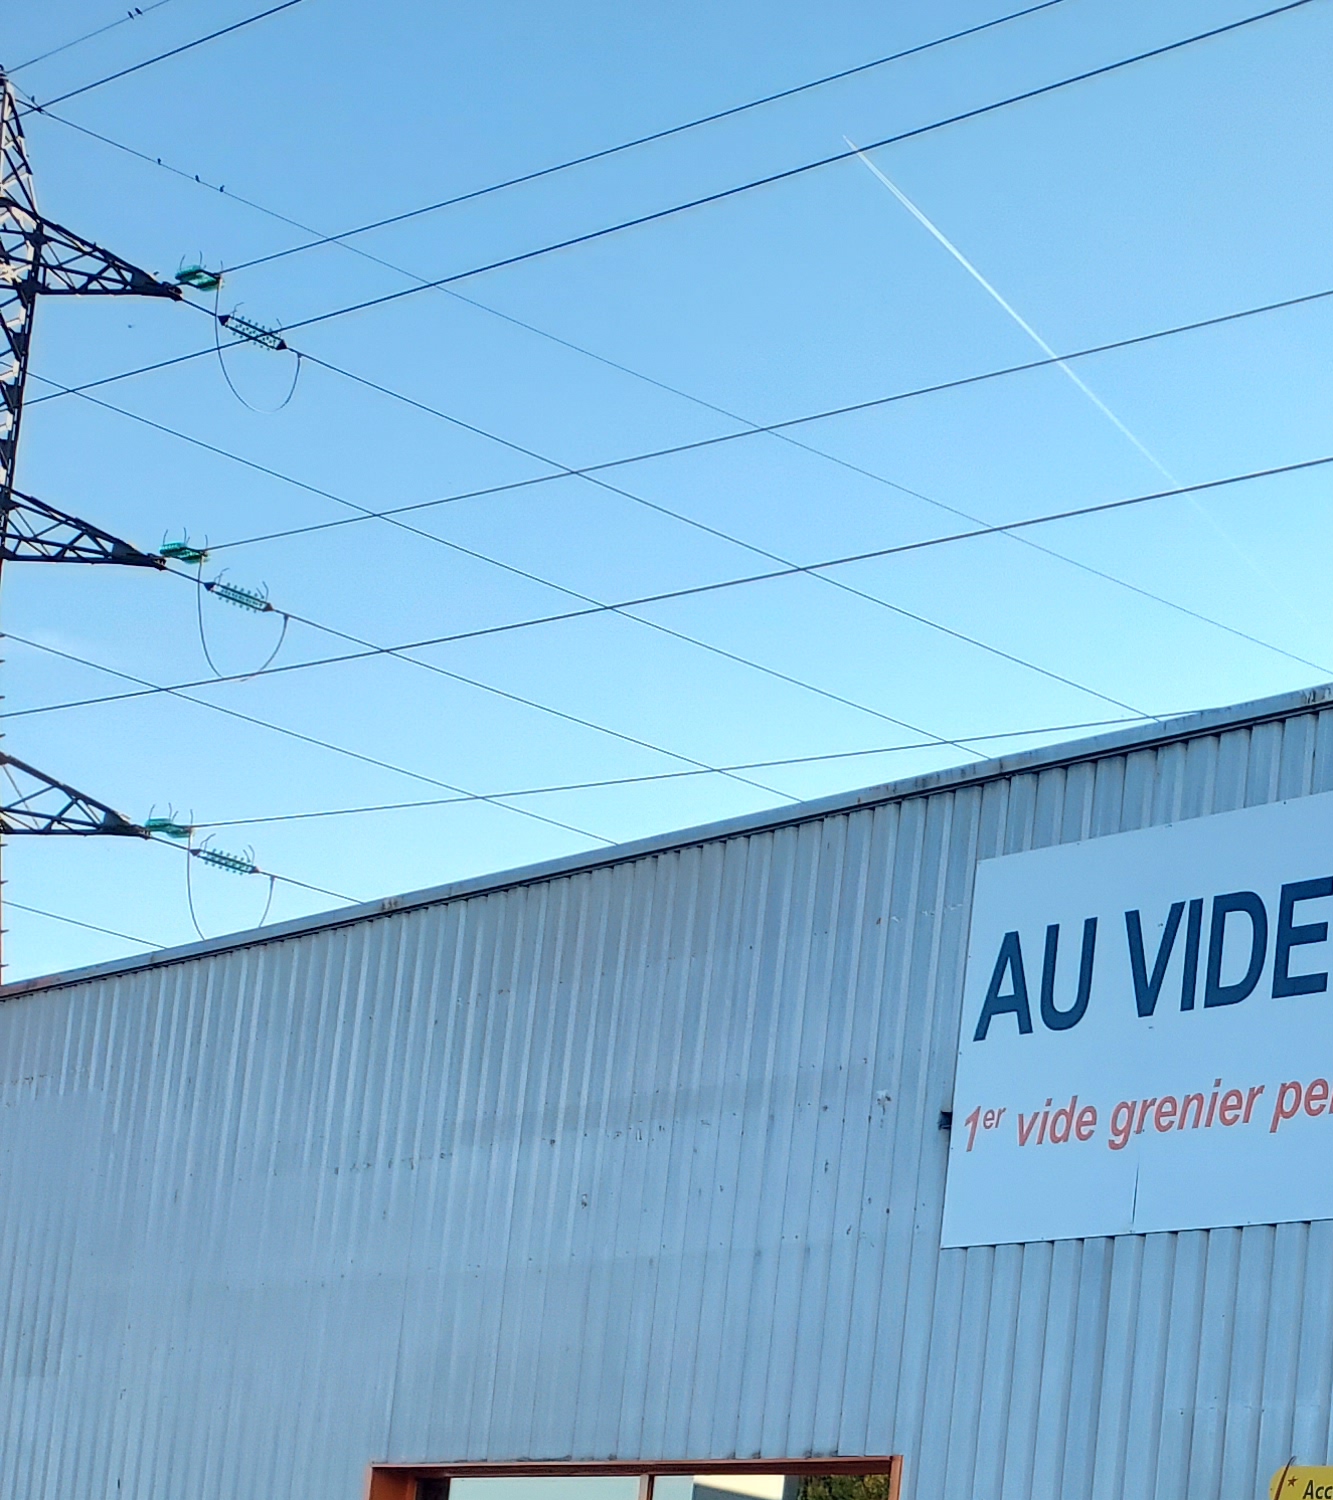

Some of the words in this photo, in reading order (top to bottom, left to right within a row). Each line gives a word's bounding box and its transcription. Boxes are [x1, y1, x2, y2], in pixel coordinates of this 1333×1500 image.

[973, 916, 1098, 1042] AU
[963, 1104, 1007, 1153] 1er
[1017, 1095, 1097, 1147] vide
[1108, 1078, 1264, 1150] grenier
